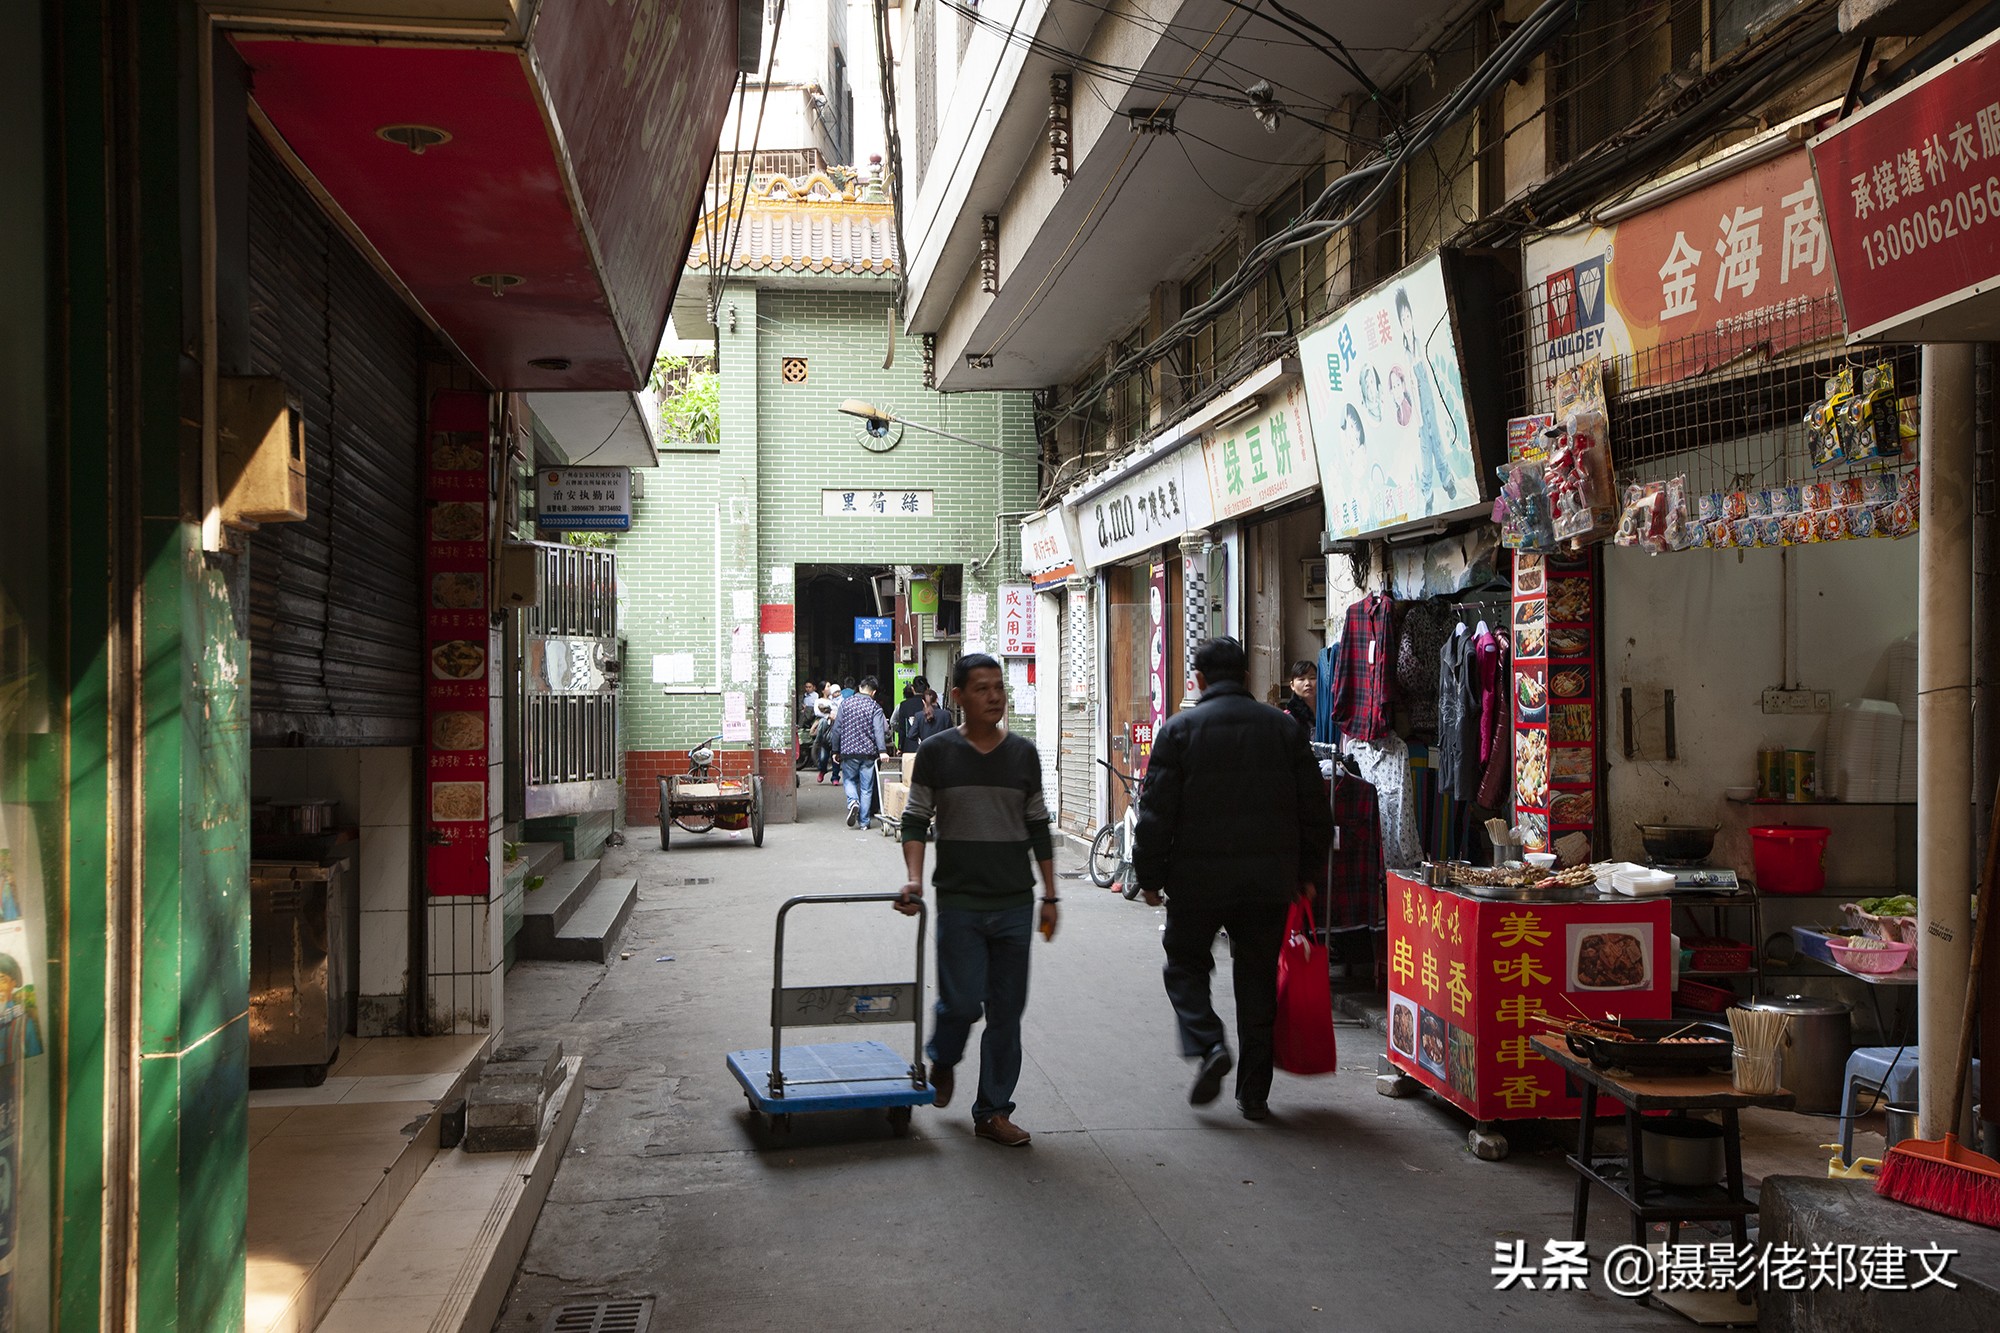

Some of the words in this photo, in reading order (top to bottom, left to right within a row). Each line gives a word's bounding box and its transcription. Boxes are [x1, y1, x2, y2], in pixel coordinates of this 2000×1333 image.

[1850, 102, 2000, 220] 承接缝补衣服
[1657, 177, 1828, 321] 金海商
[1861, 176, 2000, 271] 1306062056
[1363, 308, 1393, 352] 童装
[1548, 327, 1605, 361] AULDEY
[1223, 410, 1293, 496] 绿豆饼
[553, 490, 616, 501] 治安执勤岗
[1033, 535, 1059, 561] 风行牛奶
[1005, 590, 1022, 652] 成人用品
[1134, 725, 1152, 743] 推
[1401, 886, 1463, 946] 湛江风味
[1392, 935, 1473, 1019] 串串香
[1491, 911, 1553, 1110] 美味串串香
